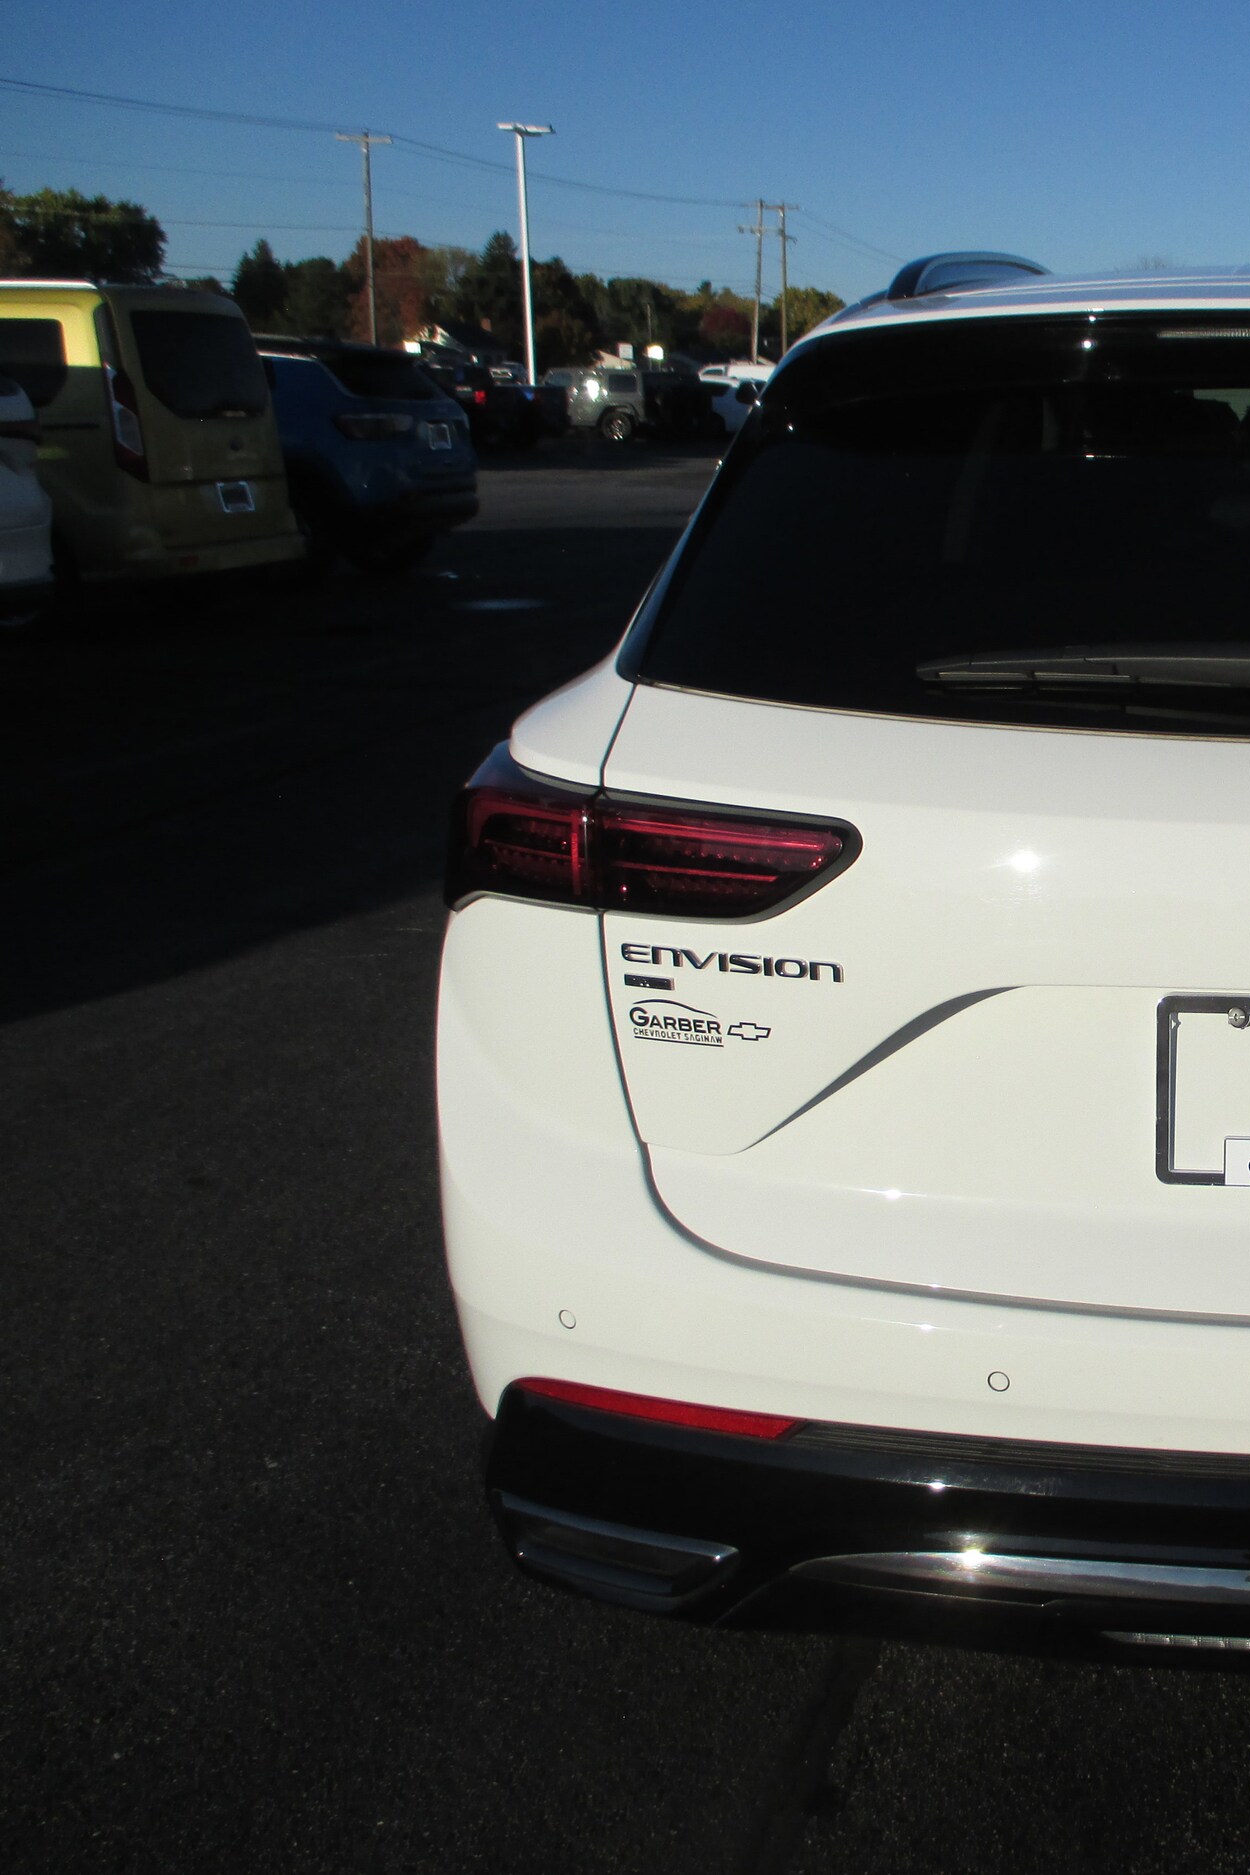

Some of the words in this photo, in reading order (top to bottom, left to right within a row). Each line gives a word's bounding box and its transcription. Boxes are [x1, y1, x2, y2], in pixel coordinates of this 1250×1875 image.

[621, 943, 844, 983] ENVISION
[629, 1006, 722, 1035] GARBER
[633, 1027, 681, 1040] CHEVROLET
[684, 1033, 723, 1044] SAGINAW
